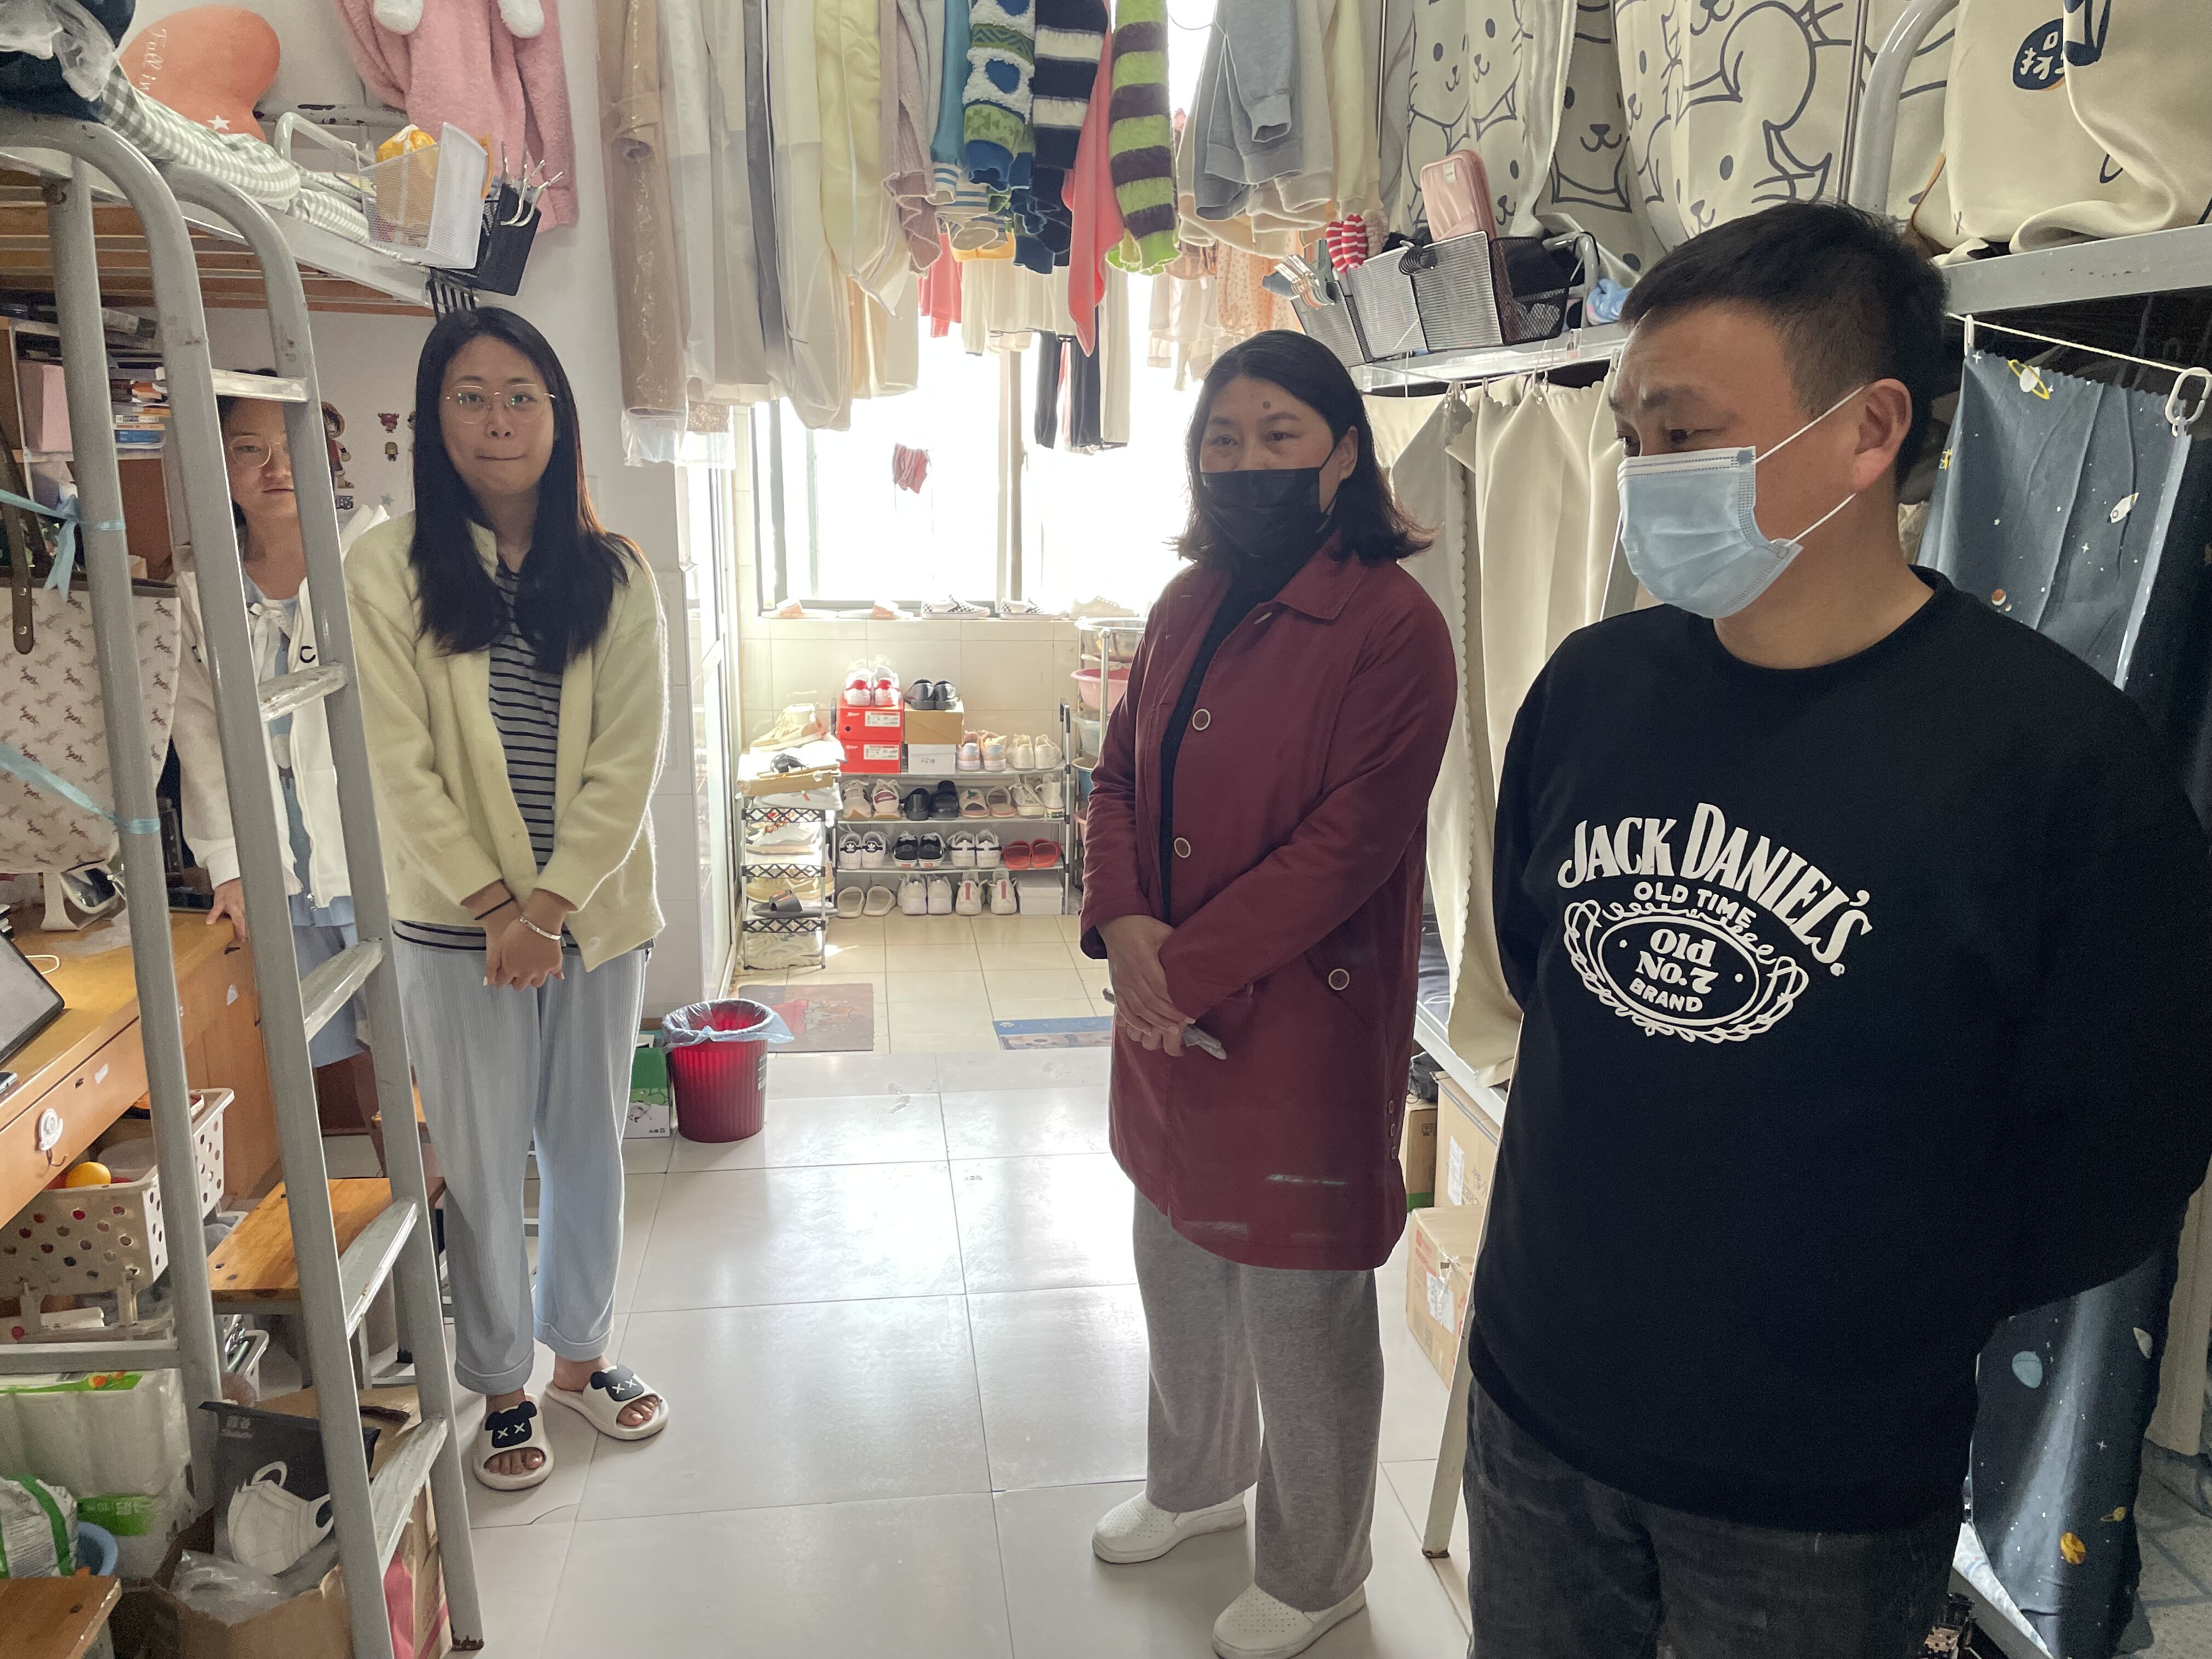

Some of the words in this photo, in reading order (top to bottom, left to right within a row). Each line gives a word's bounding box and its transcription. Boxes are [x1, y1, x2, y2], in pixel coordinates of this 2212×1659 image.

[1558, 817, 1677, 889] JACK
[1634, 882, 1694, 903] OLD
[1697, 889, 1758, 928] TIME
[1650, 928, 1717, 967] Old
[1629, 978, 1703, 1012] BRAND
